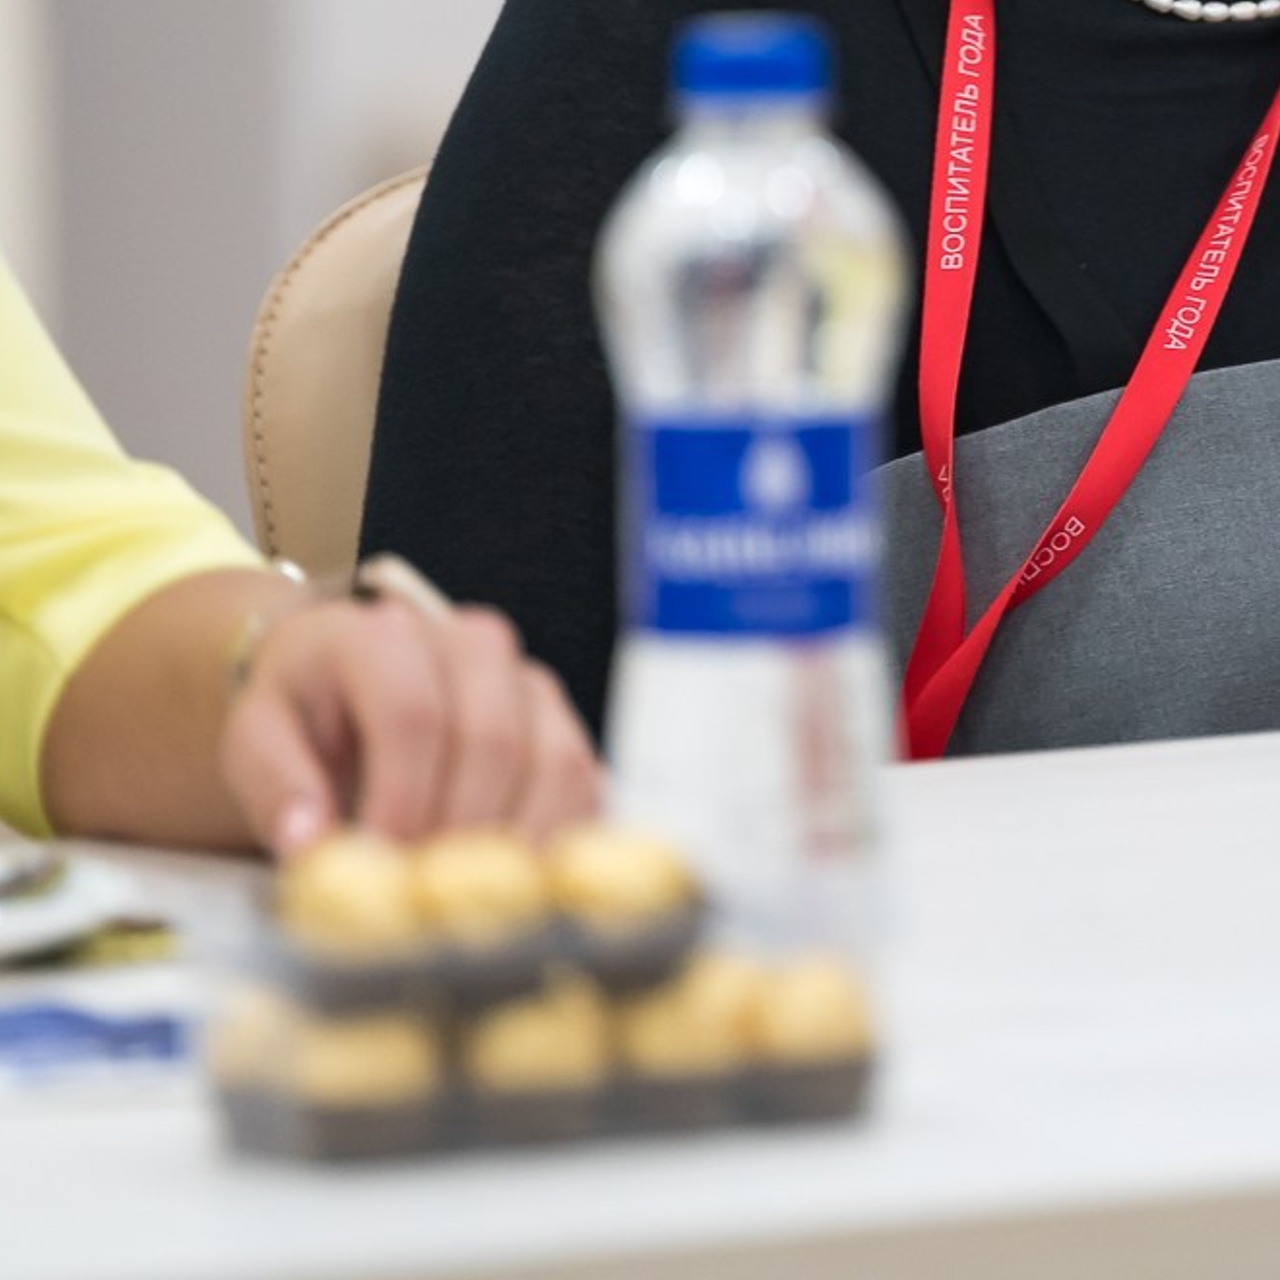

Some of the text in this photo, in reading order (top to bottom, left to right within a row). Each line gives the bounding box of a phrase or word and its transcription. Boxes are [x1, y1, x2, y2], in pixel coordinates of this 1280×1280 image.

[940, 14, 985, 270] ВОСПИТАТЕЛЬ ГОДА
[1163, 293, 1208, 350] ГОДА
